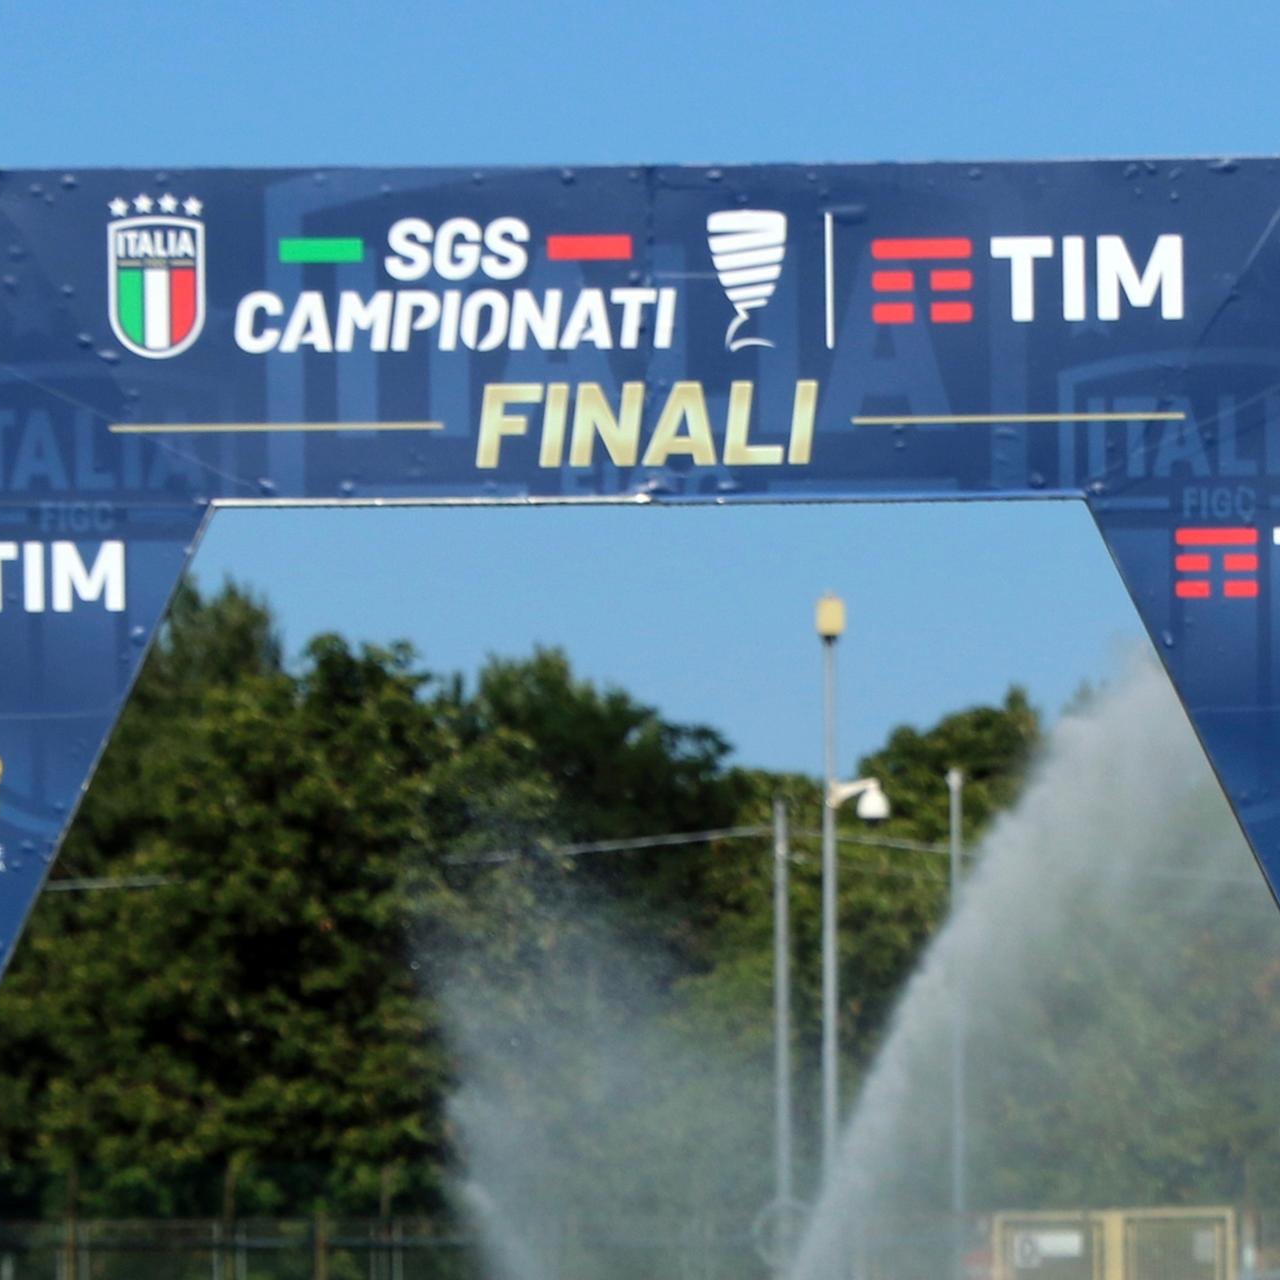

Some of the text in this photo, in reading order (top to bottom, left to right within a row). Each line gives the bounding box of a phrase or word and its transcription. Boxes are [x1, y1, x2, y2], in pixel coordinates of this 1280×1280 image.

[116, 229, 196, 257] ITALIA
[385, 217, 530, 280] SGS
[990, 233, 1184, 321] TIM
[234, 288, 677, 354] CAMPIONATI
[475, 380, 819, 469] FINALI
